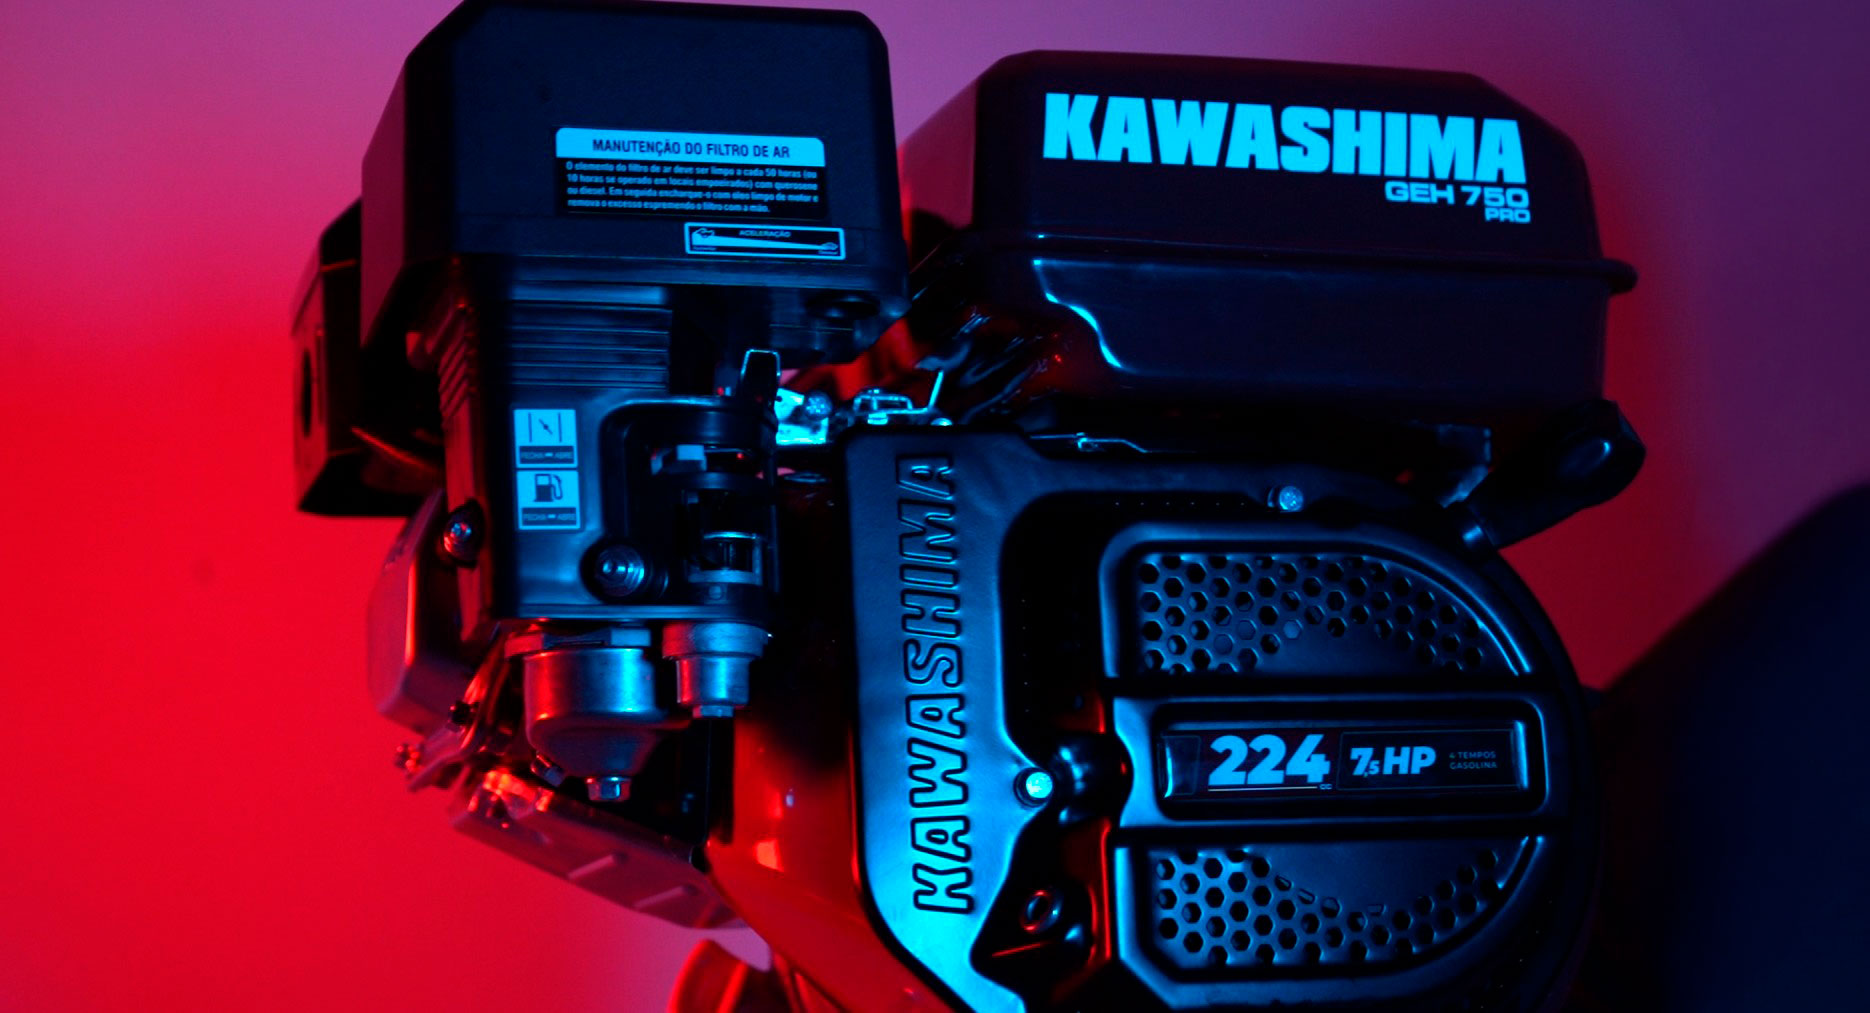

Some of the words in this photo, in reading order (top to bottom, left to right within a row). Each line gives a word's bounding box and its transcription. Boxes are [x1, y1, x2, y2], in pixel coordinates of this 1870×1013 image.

[1043, 93, 1528, 185] KAWASHIMA
[593, 139, 680, 156] MANUTENÇÃO
[685, 142, 702, 155] DO
[707, 144, 748, 156] FILTRO
[753, 145, 768, 157] DE
[773, 146, 789, 157] AR
[616, 163, 627, 172] do
[628, 163, 649, 172] filtro
[650, 165, 661, 173] de
[673, 165, 694, 174] deve
[710, 166, 735, 176] limpo
[742, 168, 764, 176] cada
[765, 168, 777, 177] 50
[778, 169, 801, 178] horas
[567, 174, 578, 182] 10
[579, 174, 604, 183] horas
[609, 187, 623, 195] Em
[752, 192, 774, 202] limpo
[775, 193, 786, 201] de
[1385, 181, 1454, 204] GEH
[1461, 186, 1530, 208] 750
[1485, 208, 1531, 223] PRO
[739, 230, 791, 238] ACELERAÇÃO
[897, 453, 974, 915] KAWASHIMA
[1209, 734, 1330, 785] 224
[1382, 747, 1436, 775] HP
[1457, 751, 1496, 759] TEMPOS
[1449, 761, 1498, 769] GASOLINA
